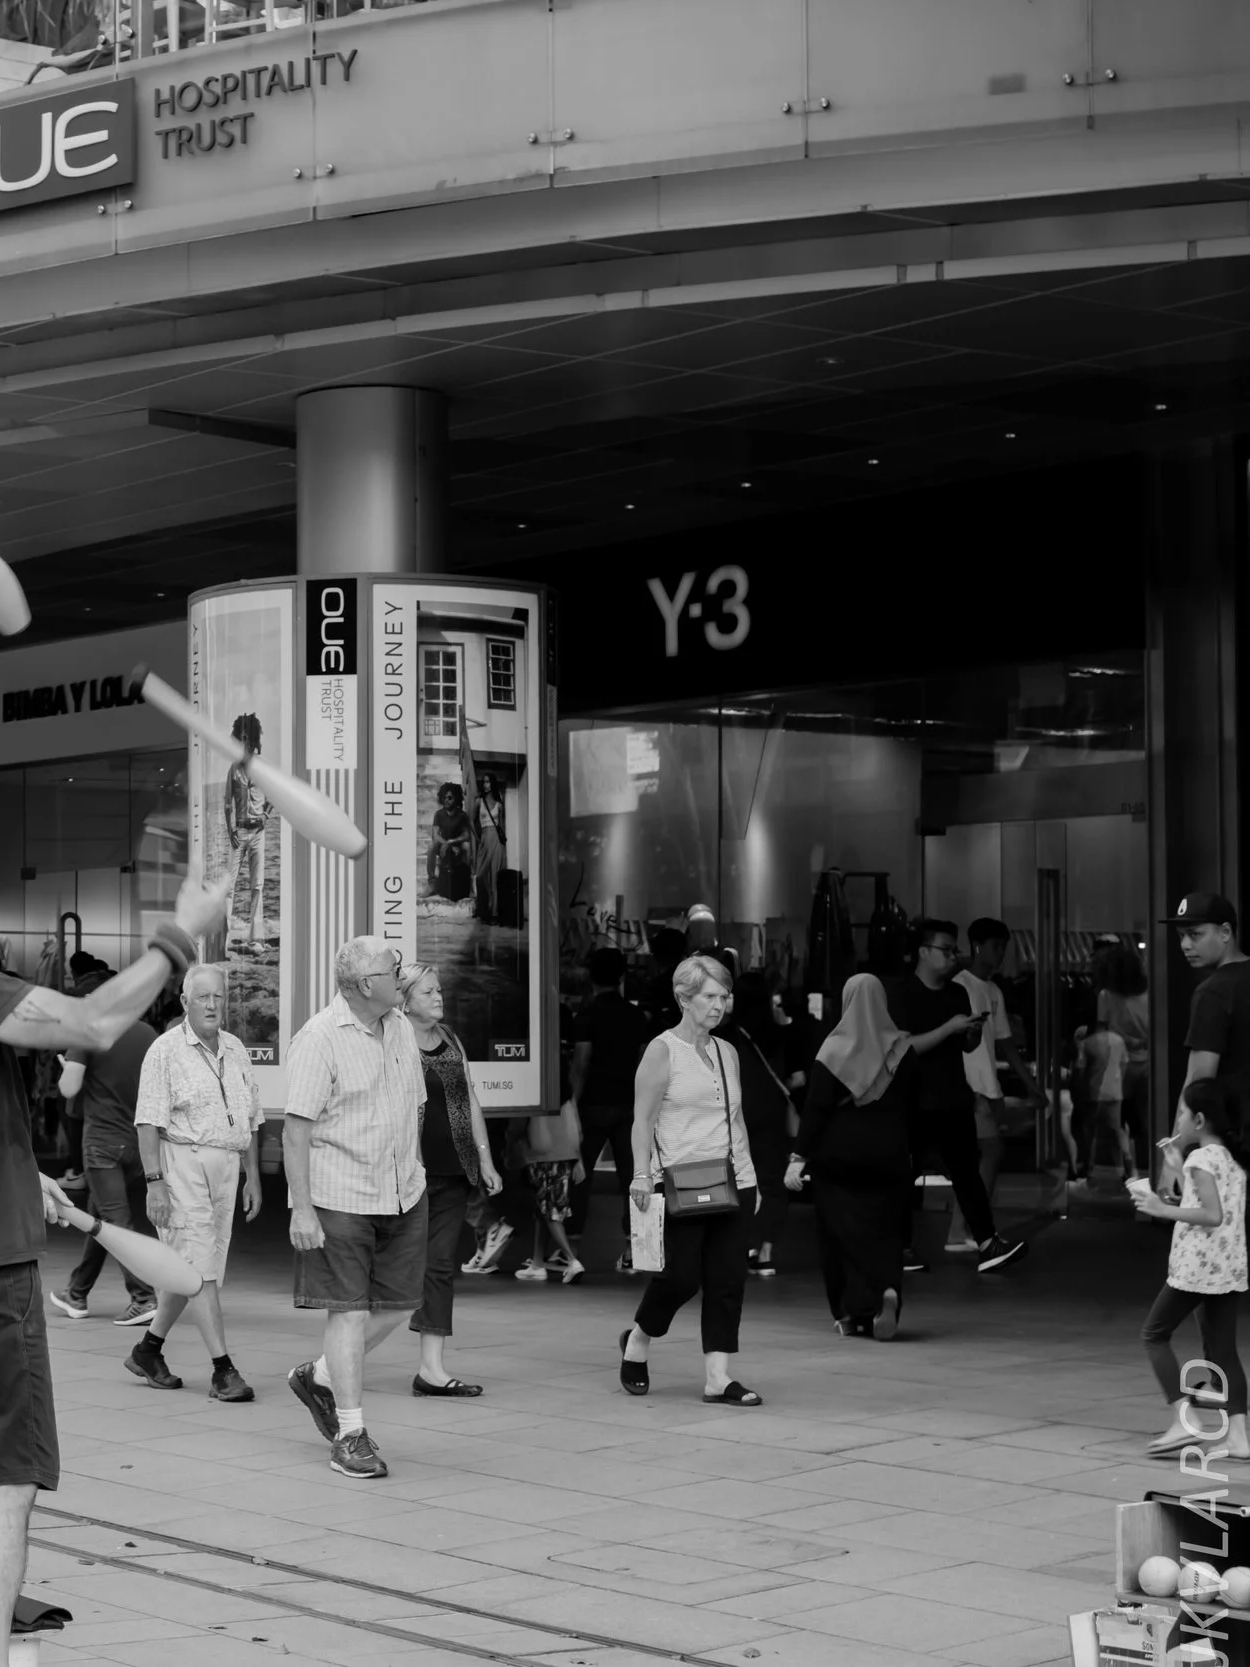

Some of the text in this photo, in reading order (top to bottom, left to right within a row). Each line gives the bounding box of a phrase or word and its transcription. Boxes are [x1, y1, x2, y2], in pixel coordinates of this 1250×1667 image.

[153, 49, 358, 118] HOSPITALITY
[155, 112, 254, 160] TRUST
[320, 587, 345, 673] OUE
[384, 601, 404, 740] JOURNEY
[2, 684, 69, 723] BIMBA
[69, 680, 87, 713] Y
[321, 679, 332, 721] TRUST
[333, 678, 344, 761] HOSPITALITY
[384, 781, 403, 836] THE
[494, 1044, 526, 1058] TUMI
[482, 1080, 513, 1090] TUMI.SG
